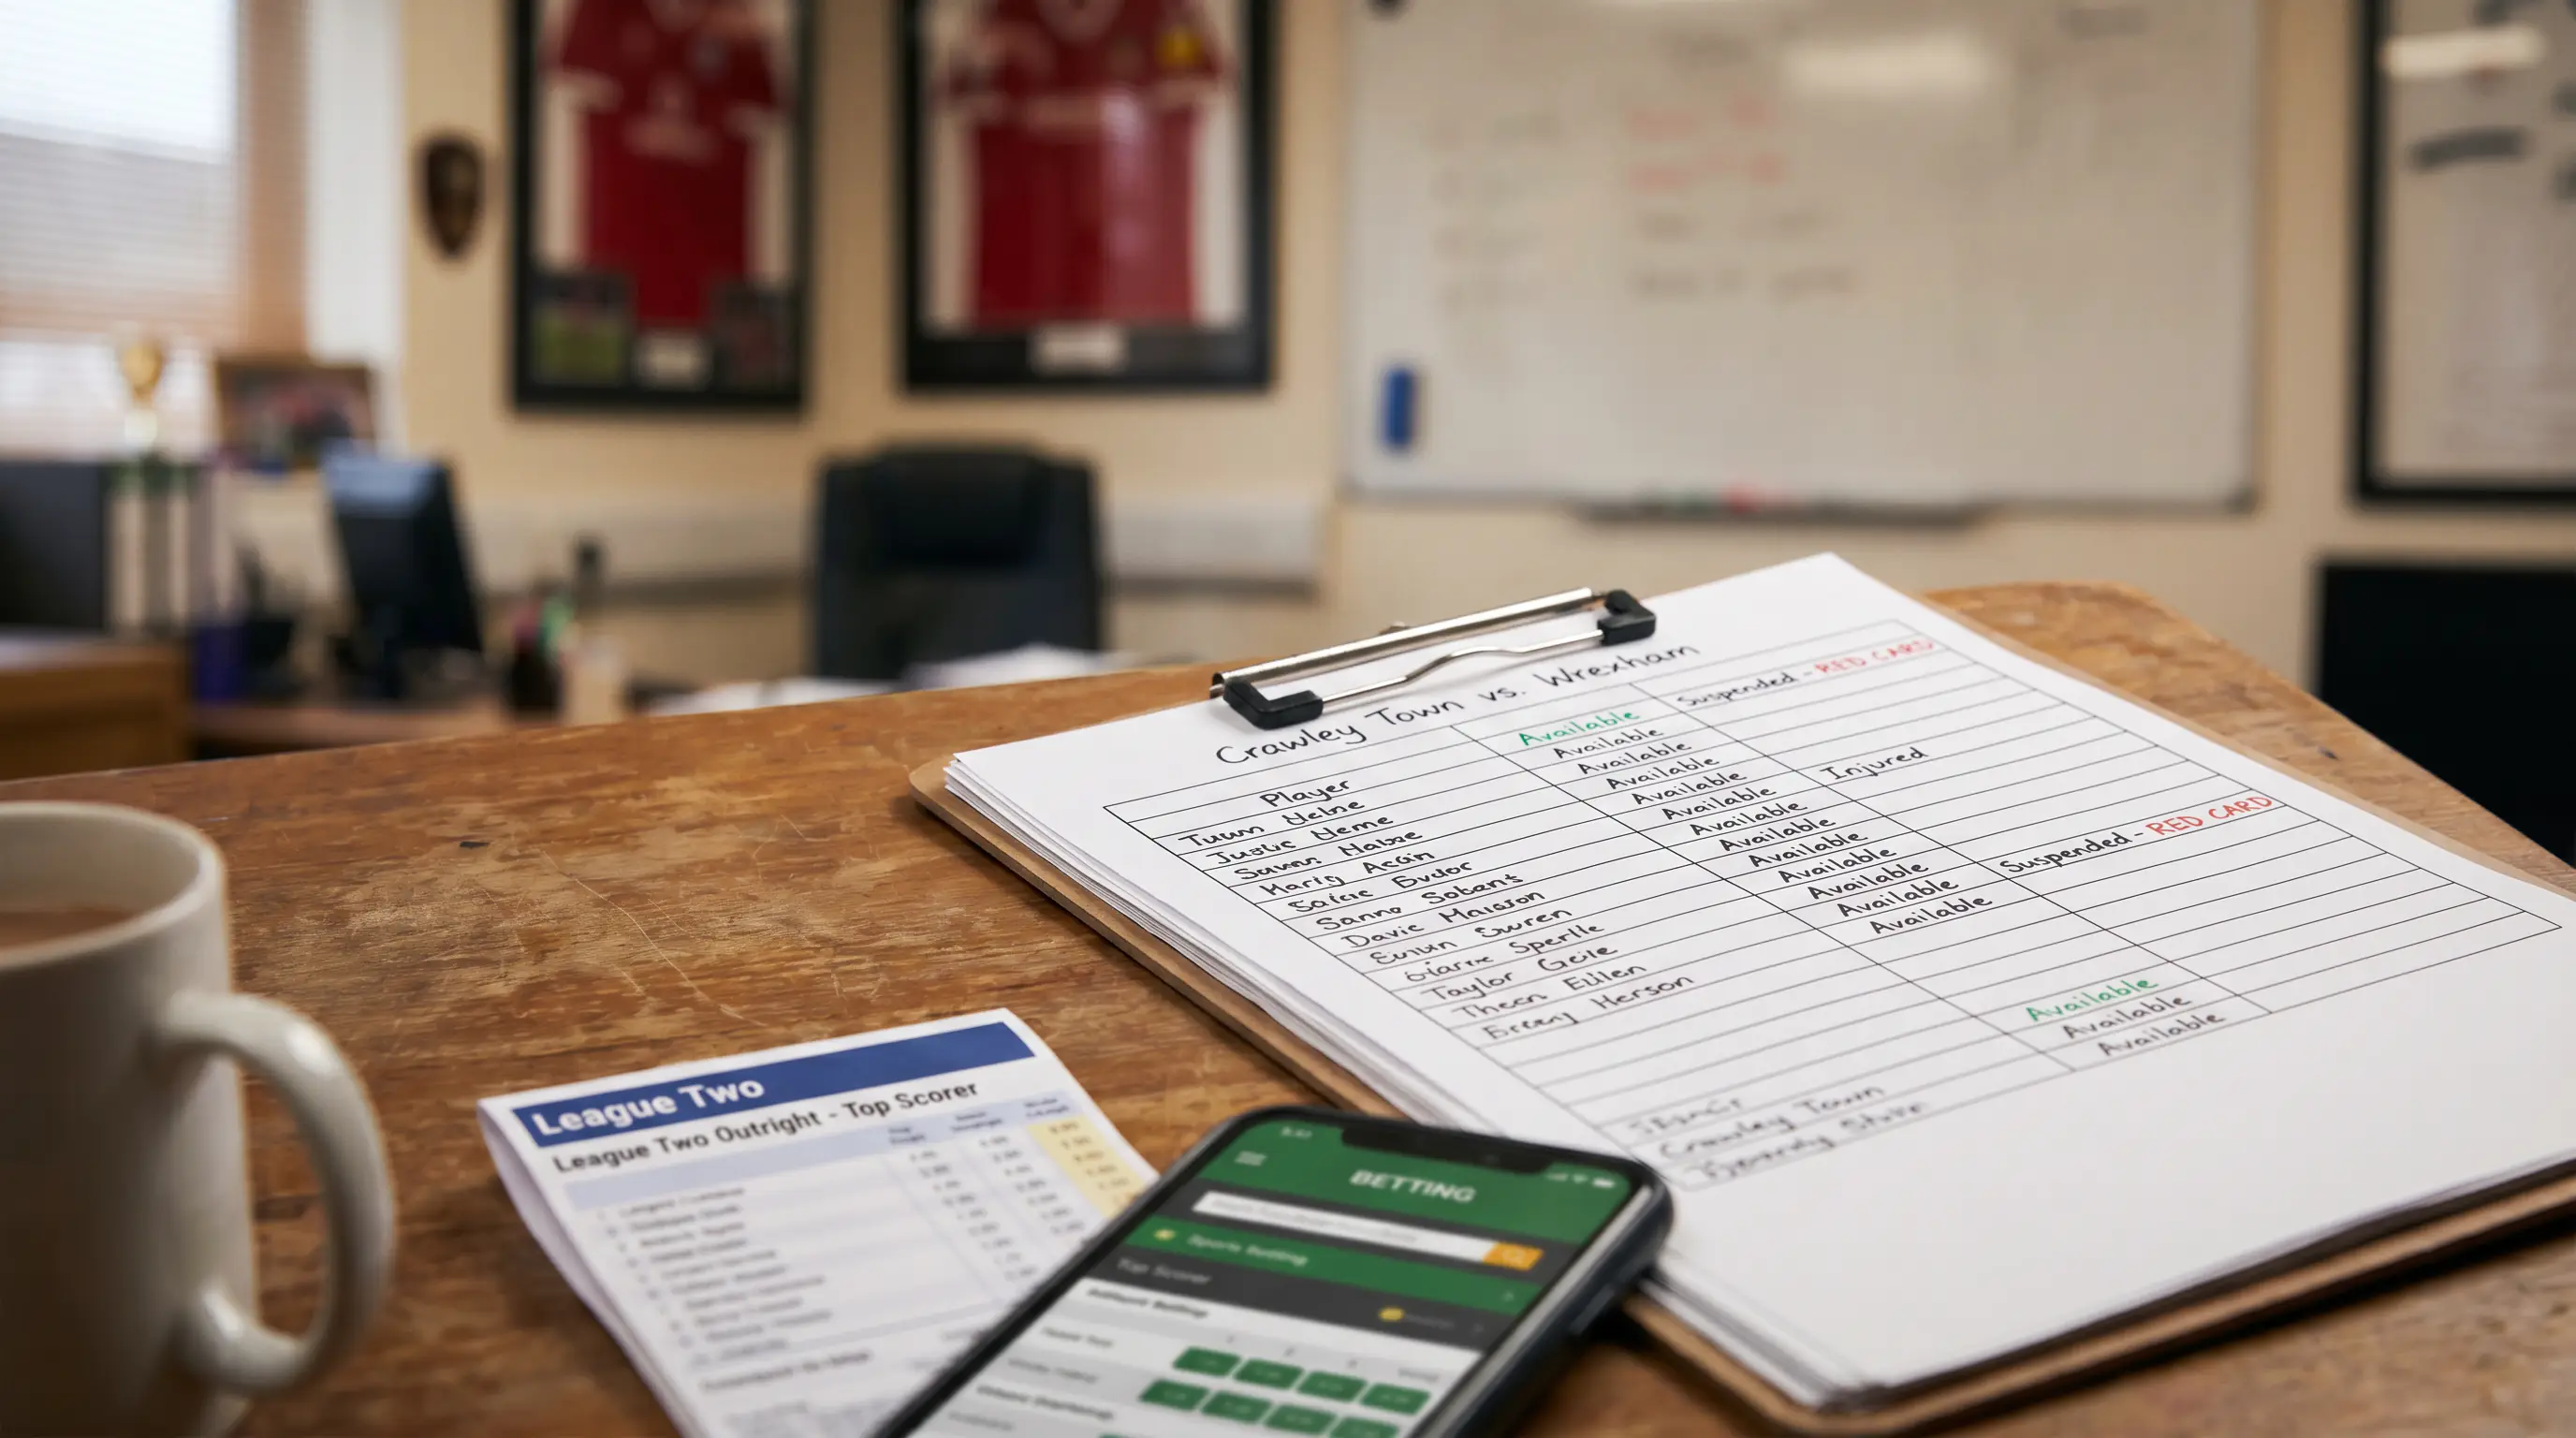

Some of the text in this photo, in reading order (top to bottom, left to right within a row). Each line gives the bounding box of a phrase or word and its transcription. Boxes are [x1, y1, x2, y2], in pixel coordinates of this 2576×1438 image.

[1676, 671, 1799, 707] Suspended
[1814, 655, 1867, 674] RED
[1871, 639, 1935, 663] CARD
[1216, 645, 1701, 764] Crawley Town vs. Wrexham
[1518, 710, 1641, 746] Available
[1553, 726, 1665, 759] Available
[1577, 741, 1693, 775] Available
[1606, 756, 1720, 790] Available
[1819, 745, 1929, 781] Injured
[1259, 779, 1351, 808] Player
[1632, 770, 1748, 805] Available
[1661, 786, 1778, 820] Available
[1690, 801, 1808, 836] Available
[1719, 816, 1837, 852] Available
[1998, 831, 2134, 873] Suspended
[2144, 814, 2204, 836] RED
[2207, 795, 2274, 821] CARD
[1748, 831, 1869, 868] Available
[1778, 847, 1897, 883] Available
[1807, 862, 1930, 900] Available
[1837, 879, 1960, 917] Available
[1869, 896, 1993, 934] Available
[1419, 971, 1514, 1000] Taylor
[2025, 978, 2159, 1022] Available
[2062, 996, 2192, 1040] Available
[2097, 1013, 2227, 1057] Available
[531, 1078, 766, 1137] League Two
[552, 1141, 651, 1174] League
[654, 1132, 710, 1154] Two
[715, 1110, 822, 1143] Outright
[842, 1099, 891, 1121] Top
[895, 1080, 979, 1110] Scorer
[1348, 1168, 1477, 1204] BETTING
